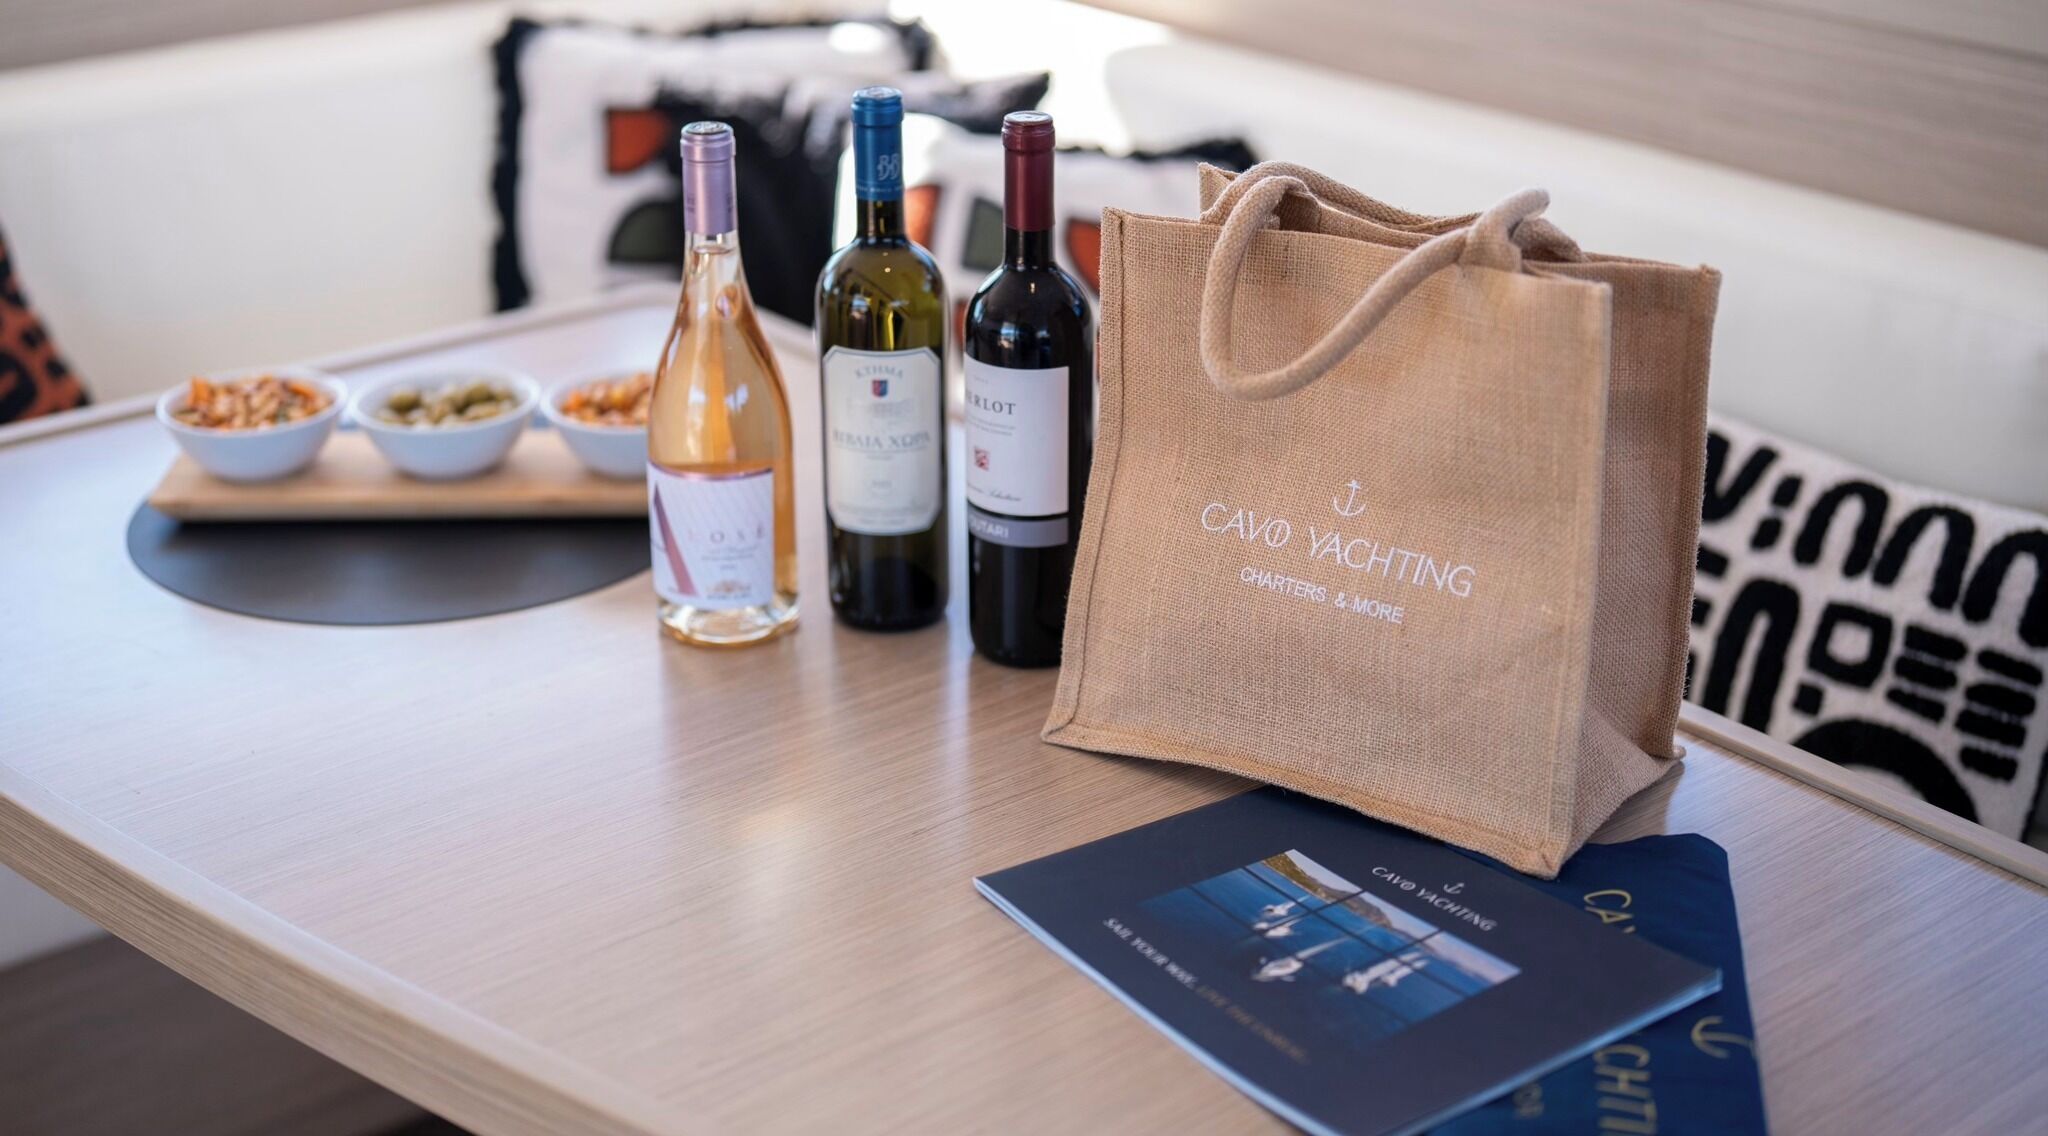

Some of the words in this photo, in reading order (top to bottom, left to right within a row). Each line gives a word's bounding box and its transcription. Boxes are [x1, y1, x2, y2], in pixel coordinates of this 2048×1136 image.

[965, 388, 1016, 416] ERLOT
[1309, 526, 1476, 597] YACHTING
[1240, 567, 1327, 602] CHARTERS
[1334, 592, 1347, 609] &
[1352, 594, 1404, 624] MORE
[1416, 887, 1497, 931] YACHTING
